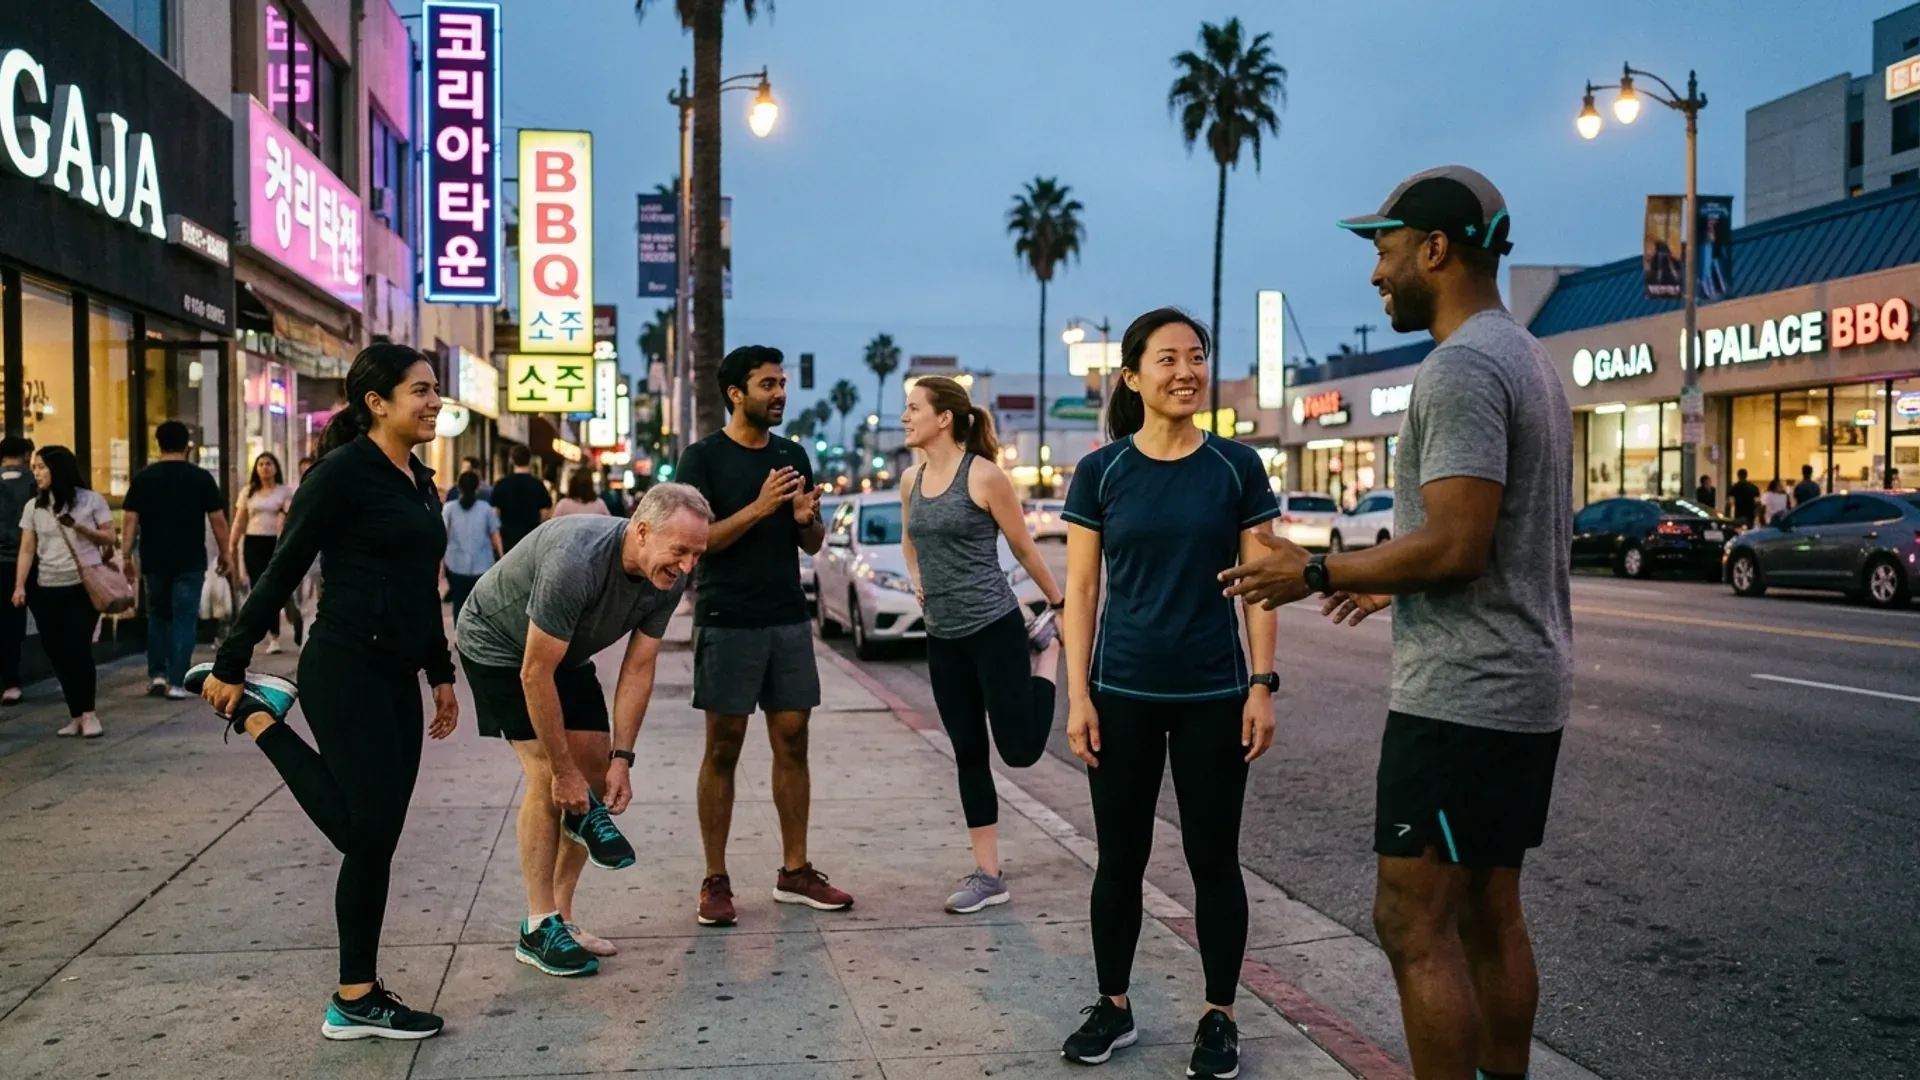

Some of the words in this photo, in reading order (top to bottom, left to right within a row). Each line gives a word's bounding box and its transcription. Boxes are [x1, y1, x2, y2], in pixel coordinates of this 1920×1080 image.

[0, 48, 167, 240] GAJA
[436, 13, 490, 288] 코리아타운
[533, 150, 580, 301] BBQ
[528, 310, 584, 341] 소주
[1704, 311, 1822, 367] PALACE
[1832, 297, 1910, 348] BBQ
[516, 364, 586, 402] 소주
[1594, 342, 1653, 381] GAJA
